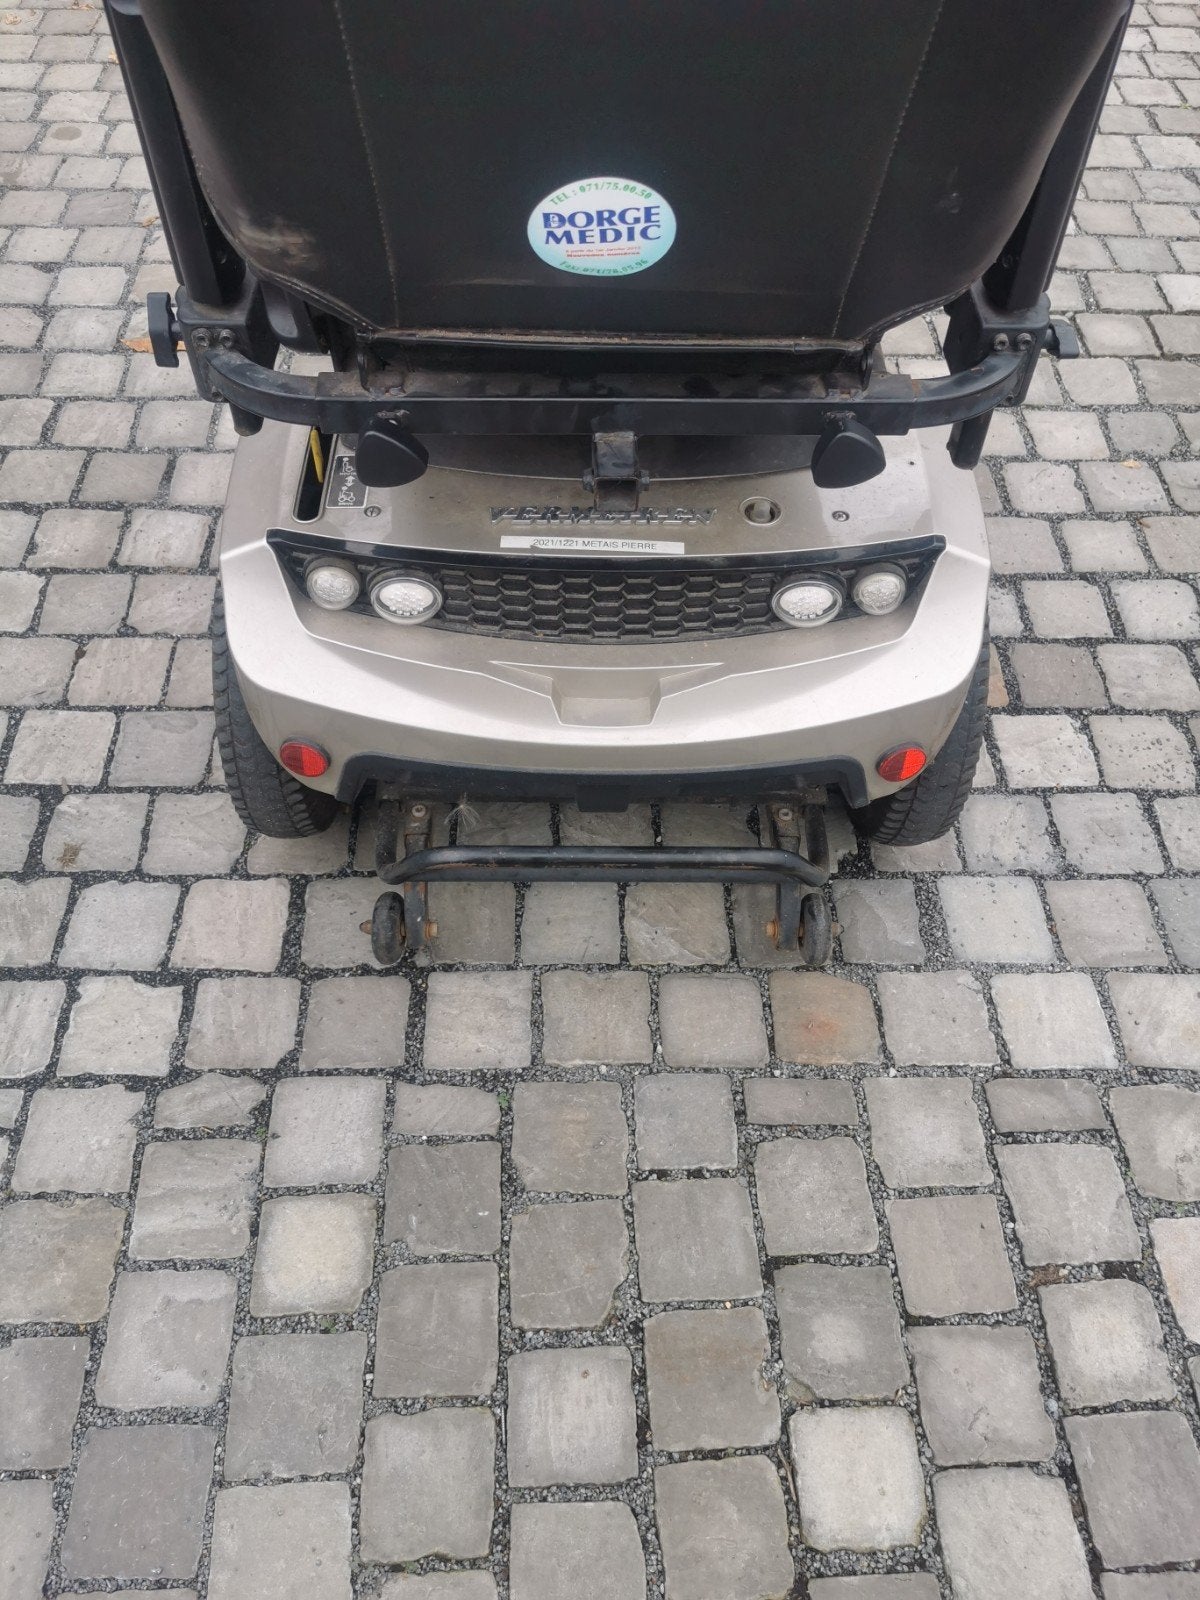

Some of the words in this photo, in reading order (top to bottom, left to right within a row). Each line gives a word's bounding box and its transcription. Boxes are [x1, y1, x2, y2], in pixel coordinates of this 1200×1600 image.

[550, 192, 569, 205] TEL
[542, 205, 661, 229] DORGE
[545, 224, 662, 245] MEDIC
[533, 538, 579, 549] 2021/1221
[581, 540, 620, 550] METAIS
[621, 541, 658, 551] PIERRE
